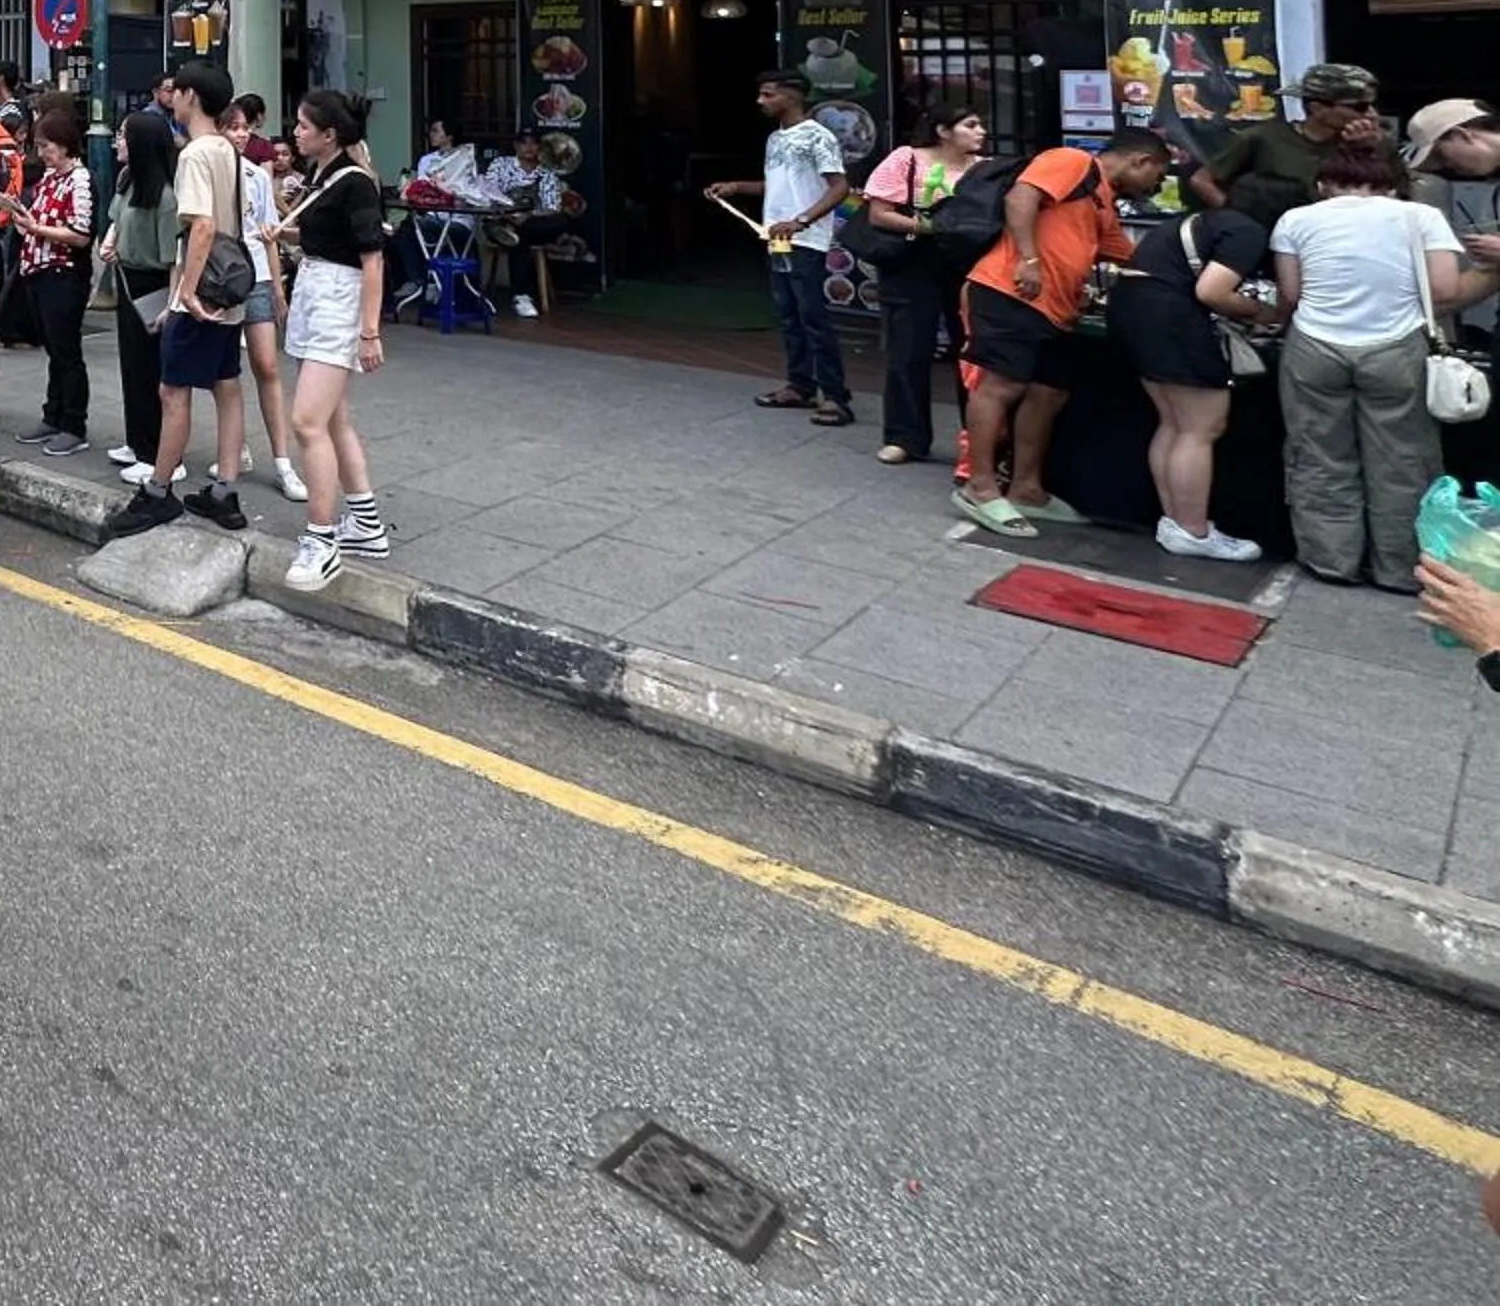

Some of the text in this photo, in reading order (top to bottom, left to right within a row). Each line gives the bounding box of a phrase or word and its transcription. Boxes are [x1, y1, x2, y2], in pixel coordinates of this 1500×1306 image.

[1129, 6, 1262, 25] Fruit Juice Series
